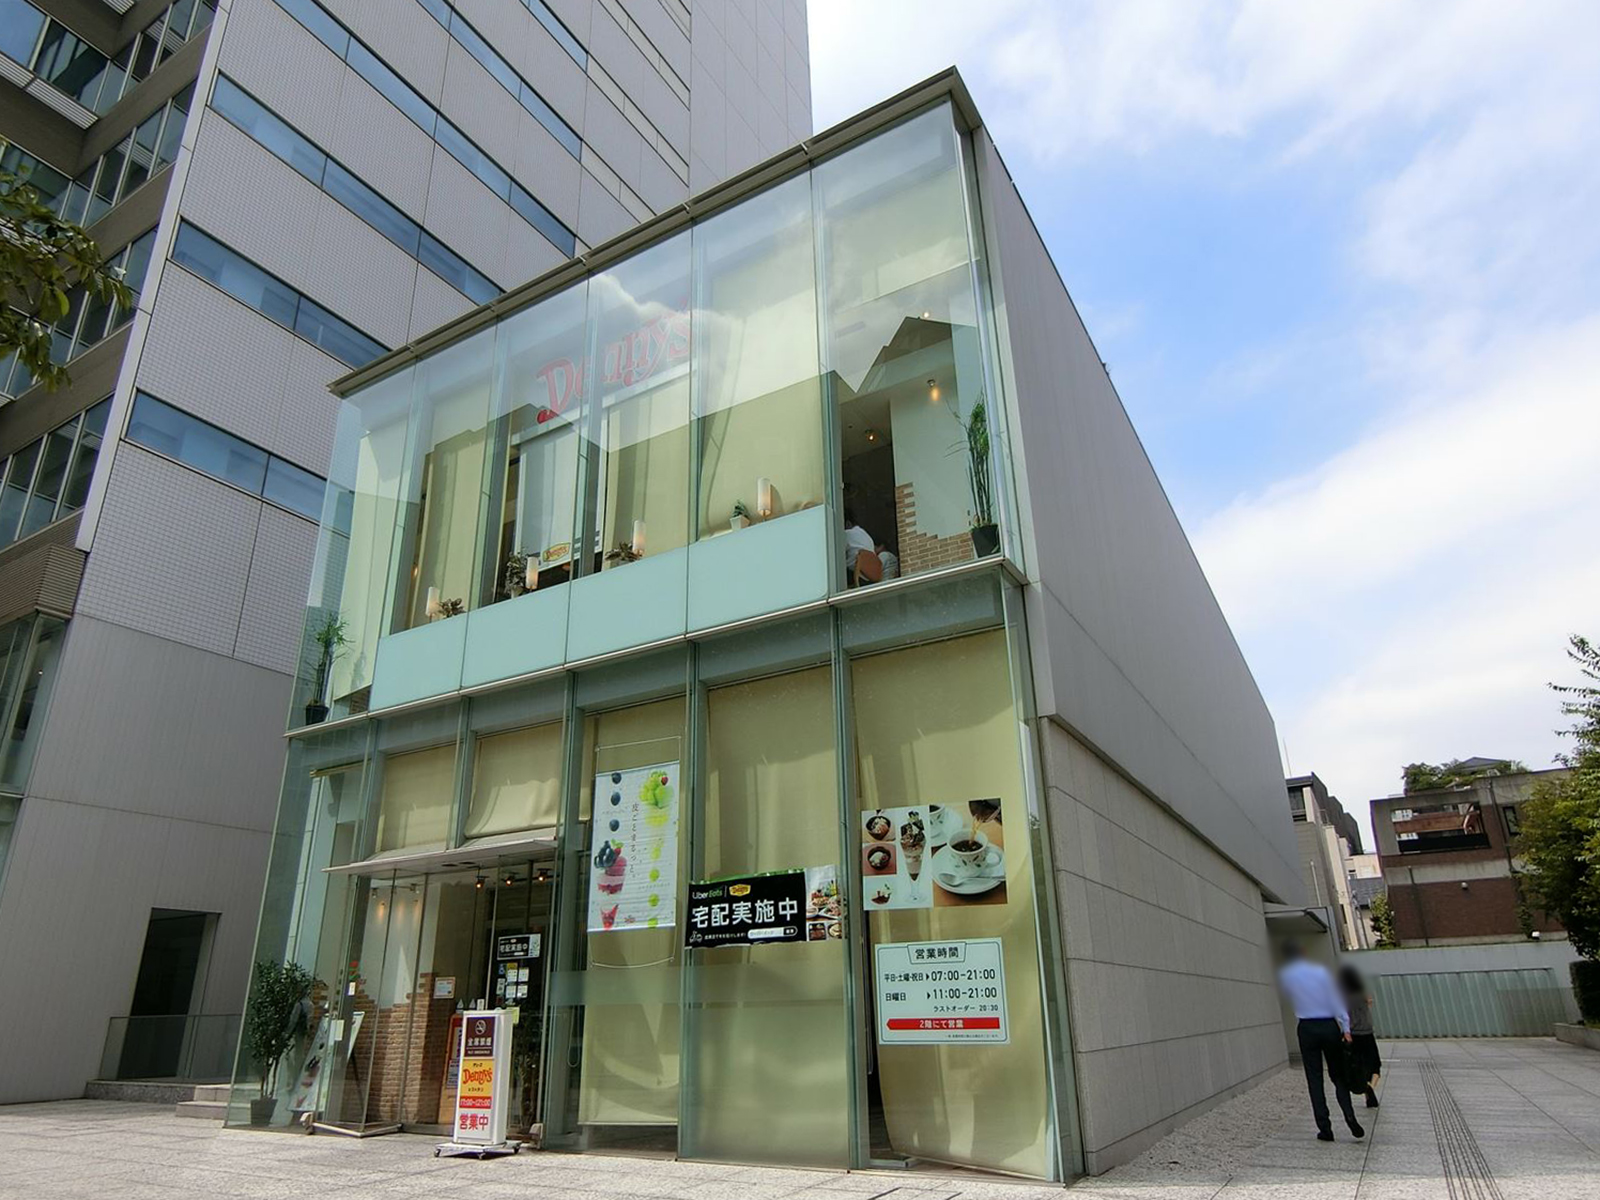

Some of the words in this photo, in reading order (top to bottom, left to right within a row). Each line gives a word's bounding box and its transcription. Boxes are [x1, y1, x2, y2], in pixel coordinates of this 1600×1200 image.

[692, 891, 709, 899] Uber
[691, 897, 798, 928] 宅配実施中
[915, 947, 960, 960] 営業時間
[931, 968, 996, 981] 07:00-21:00
[885, 992, 907, 1002] 日曜日
[933, 987, 998, 999] 11:00-21:00
[933, 1005, 976, 1013] ラストオーダー
[979, 1004, 999, 1012] 20:30
[919, 1019, 964, 1029] 2階にて営業
[462, 1067, 493, 1085] Denny's
[459, 1113, 489, 1131] 営業中
